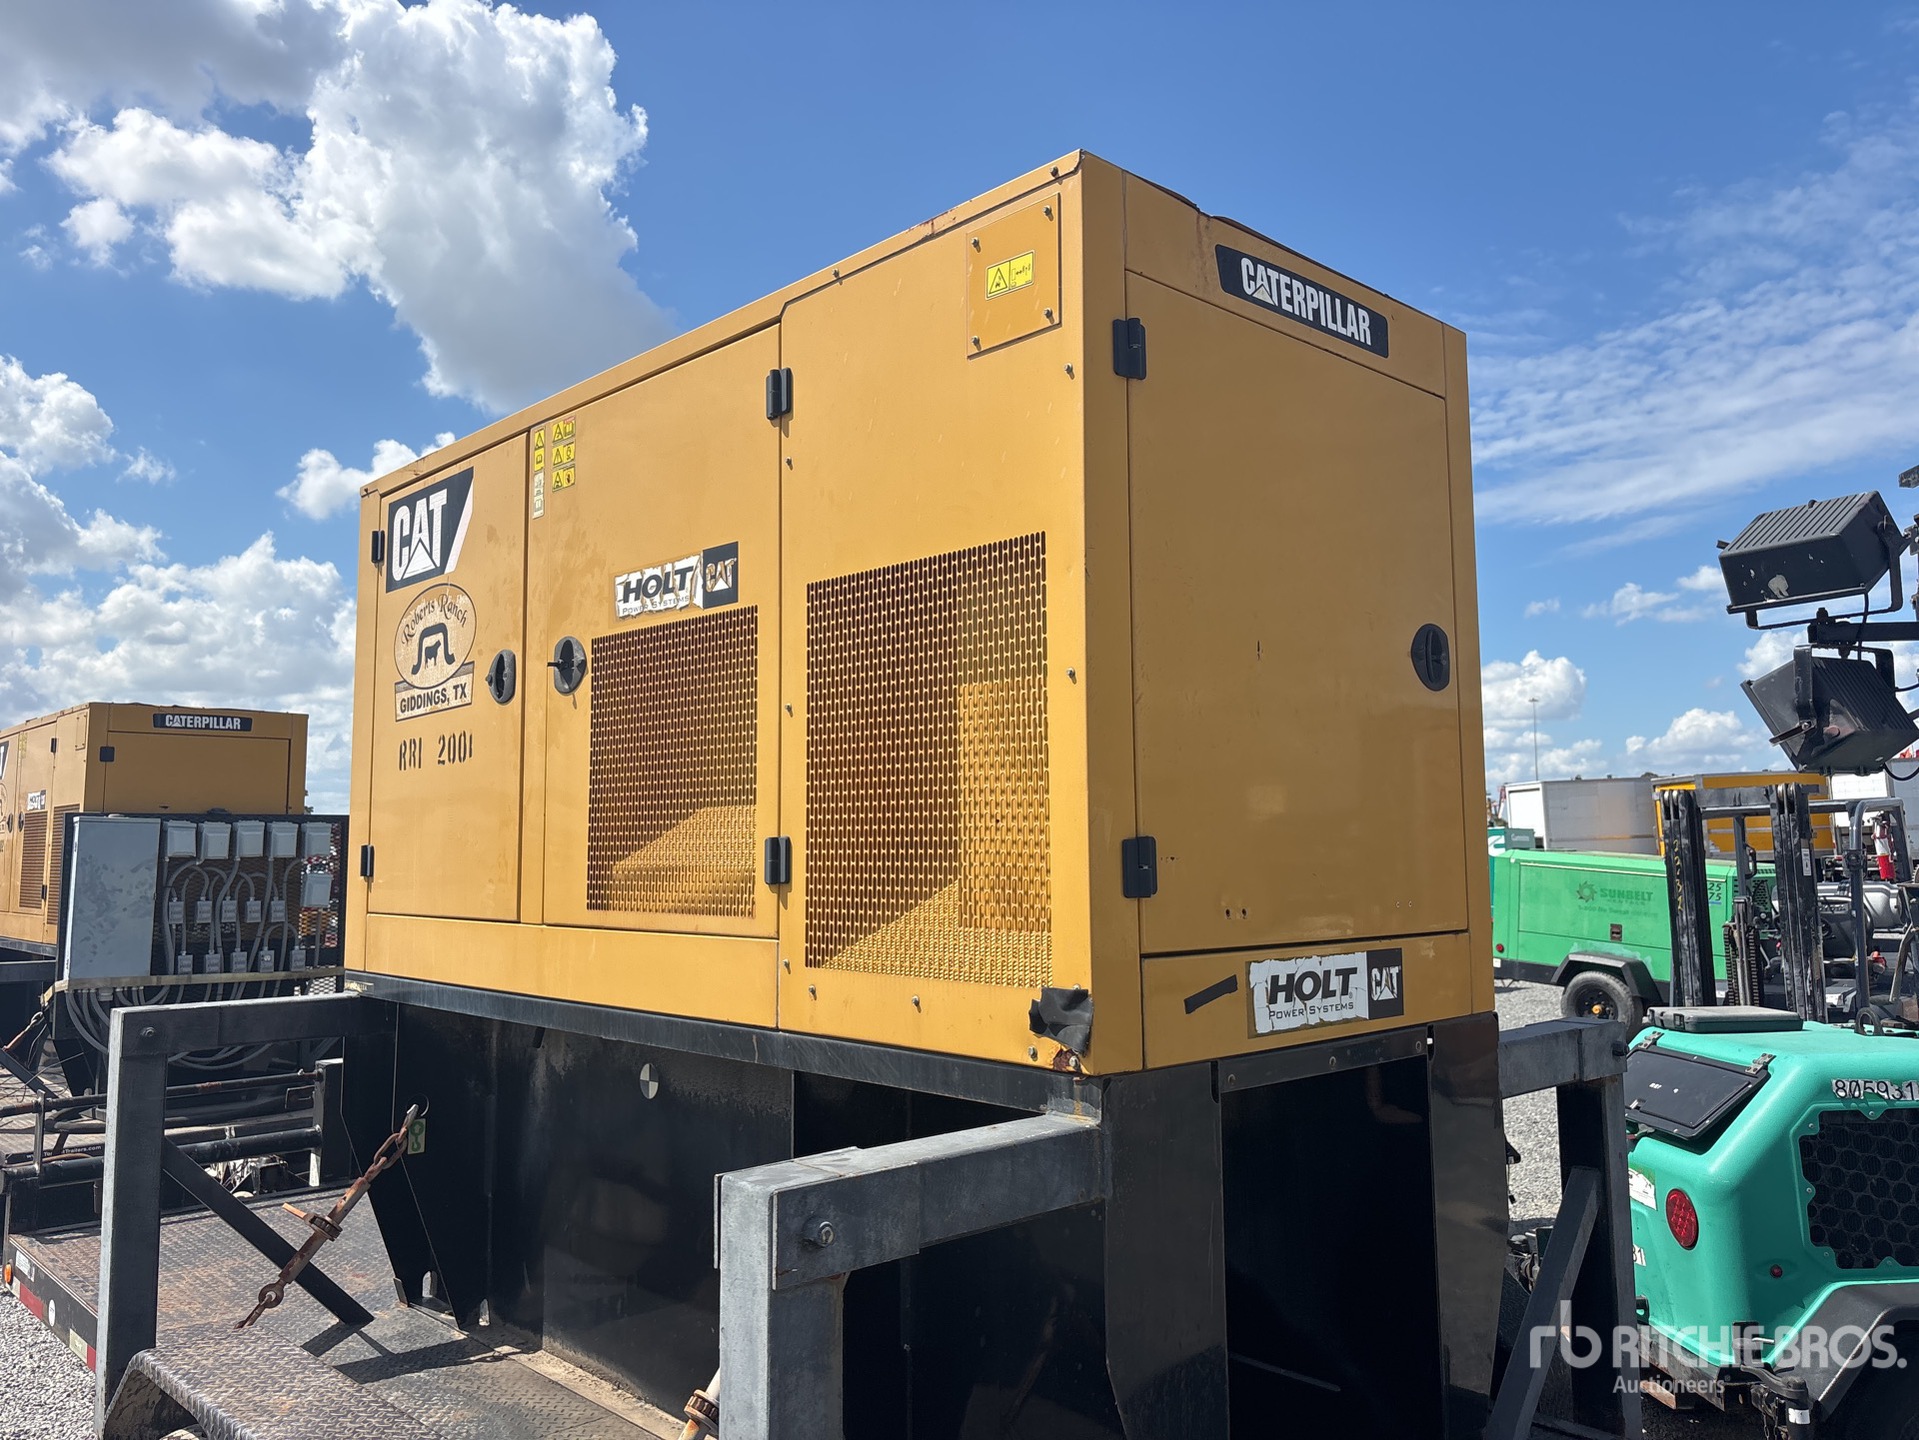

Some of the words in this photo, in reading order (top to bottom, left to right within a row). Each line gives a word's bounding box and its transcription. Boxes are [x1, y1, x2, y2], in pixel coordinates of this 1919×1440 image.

[1240, 257, 1372, 346] CATERPILLAR
[392, 488, 448, 581] CAT
[622, 565, 694, 604] HOLT
[705, 558, 738, 593] CAT
[401, 600, 436, 646] Roberts
[437, 593, 468, 629] Ranch
[400, 687, 450, 714] GIDDINGS,
[452, 682, 468, 701] TX
[165, 714, 241, 731] CATERPILLAR
[437, 729, 474, 766] 2001
[1600, 887, 1654, 902] SUNBELT
[1268, 966, 1358, 1005] HOLT
[1370, 965, 1401, 1001] CAT
